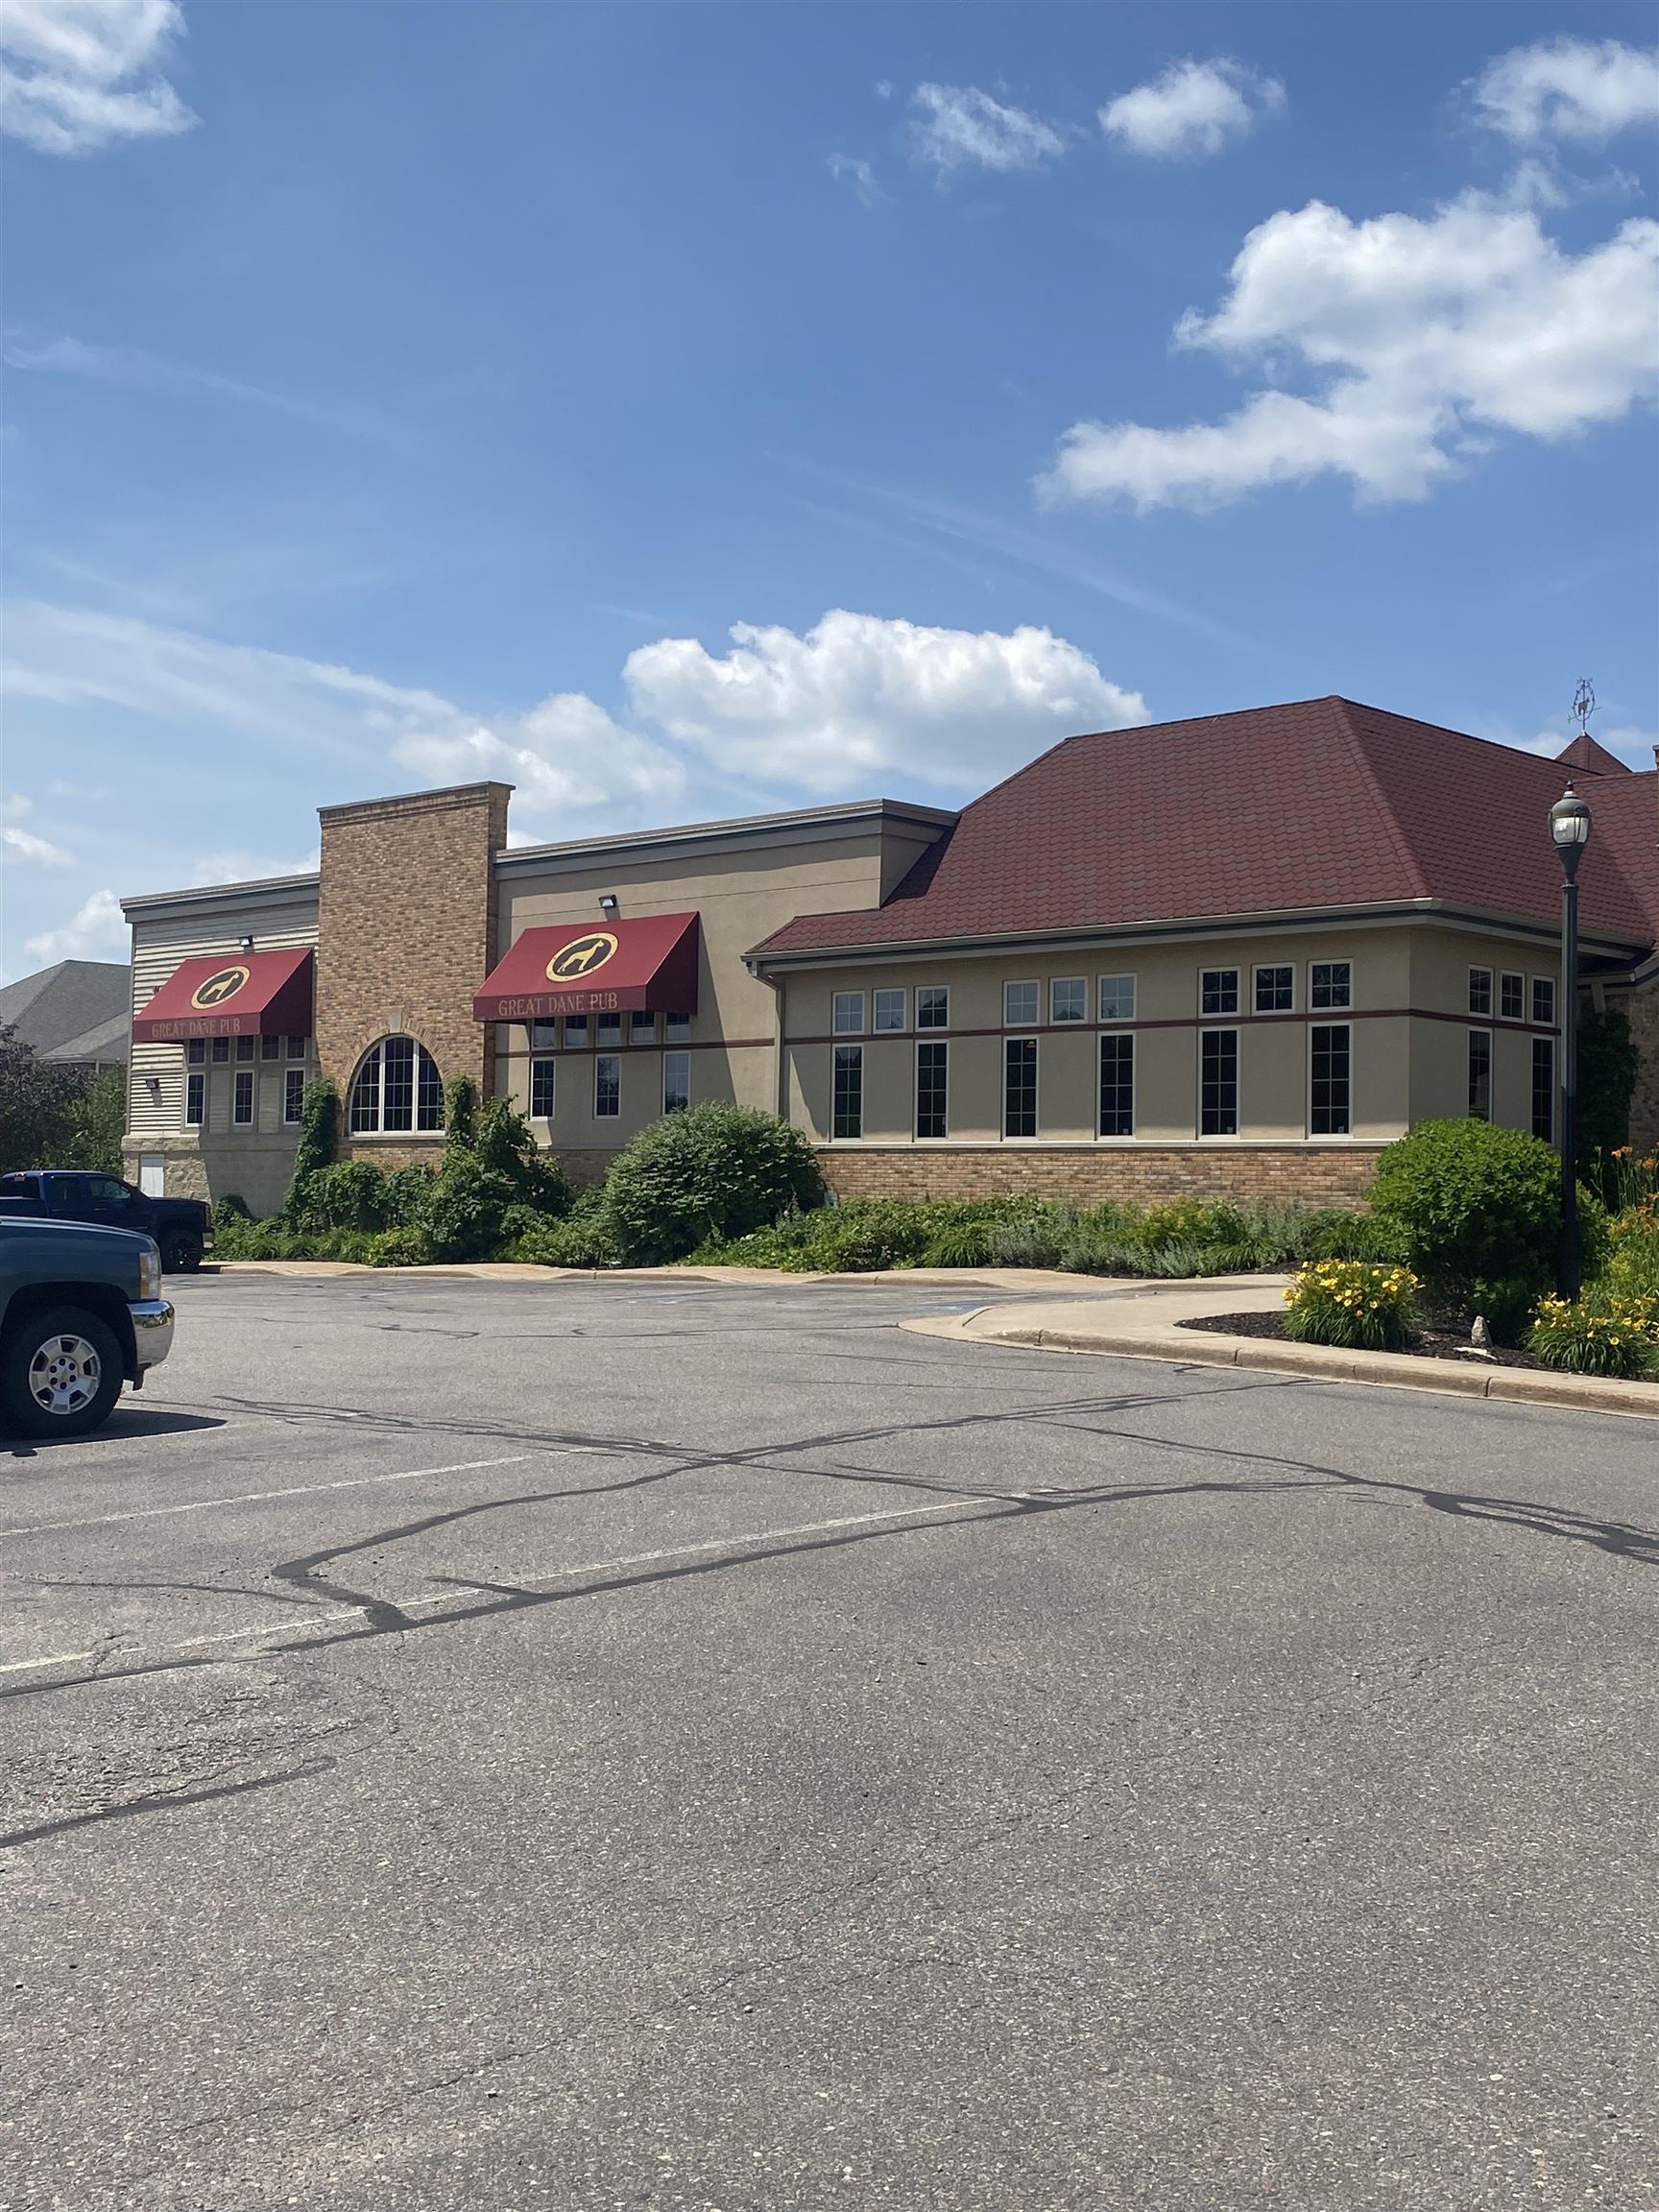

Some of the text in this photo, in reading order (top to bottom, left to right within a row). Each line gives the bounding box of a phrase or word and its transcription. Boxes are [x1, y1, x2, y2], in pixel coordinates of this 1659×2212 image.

[498, 992, 617, 1017] GREAT DANE PUB
[152, 1018, 240, 1038] GREAT DANE PUB
